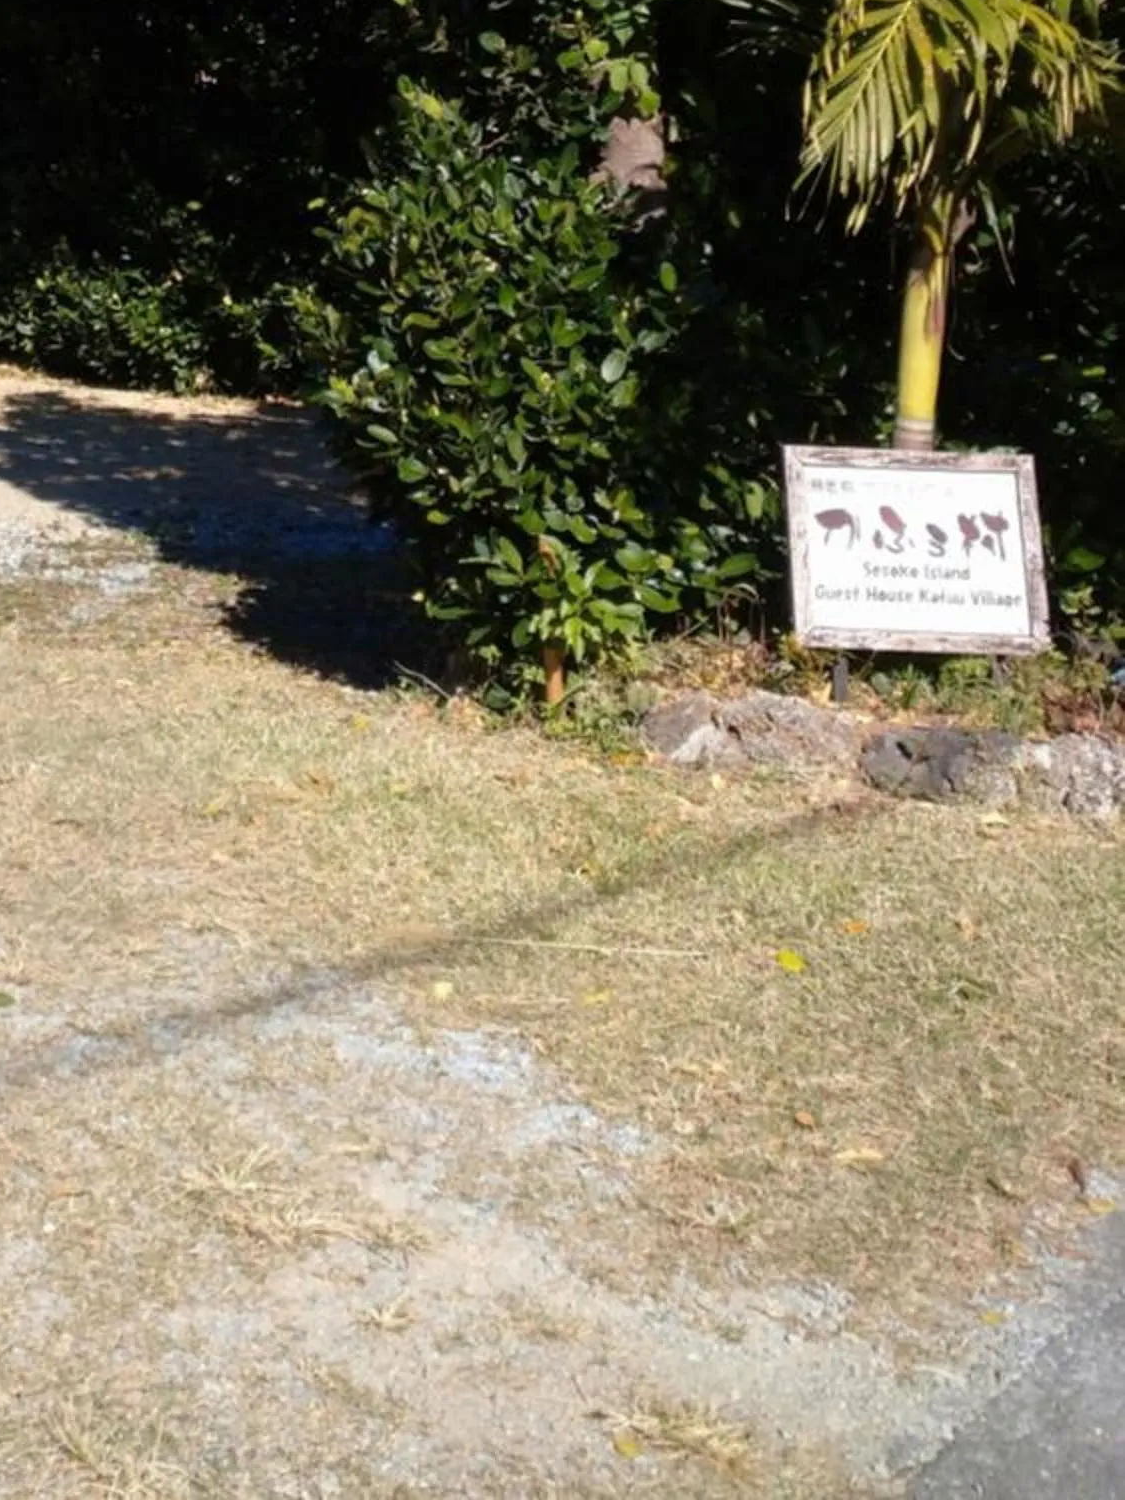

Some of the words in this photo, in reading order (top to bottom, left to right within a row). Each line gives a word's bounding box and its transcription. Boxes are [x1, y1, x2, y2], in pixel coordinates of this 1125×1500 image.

[923, 563, 971, 581] Island
[815, 584, 860, 602] Guest
[865, 586, 914, 603] House
[970, 589, 1023, 608] Village
